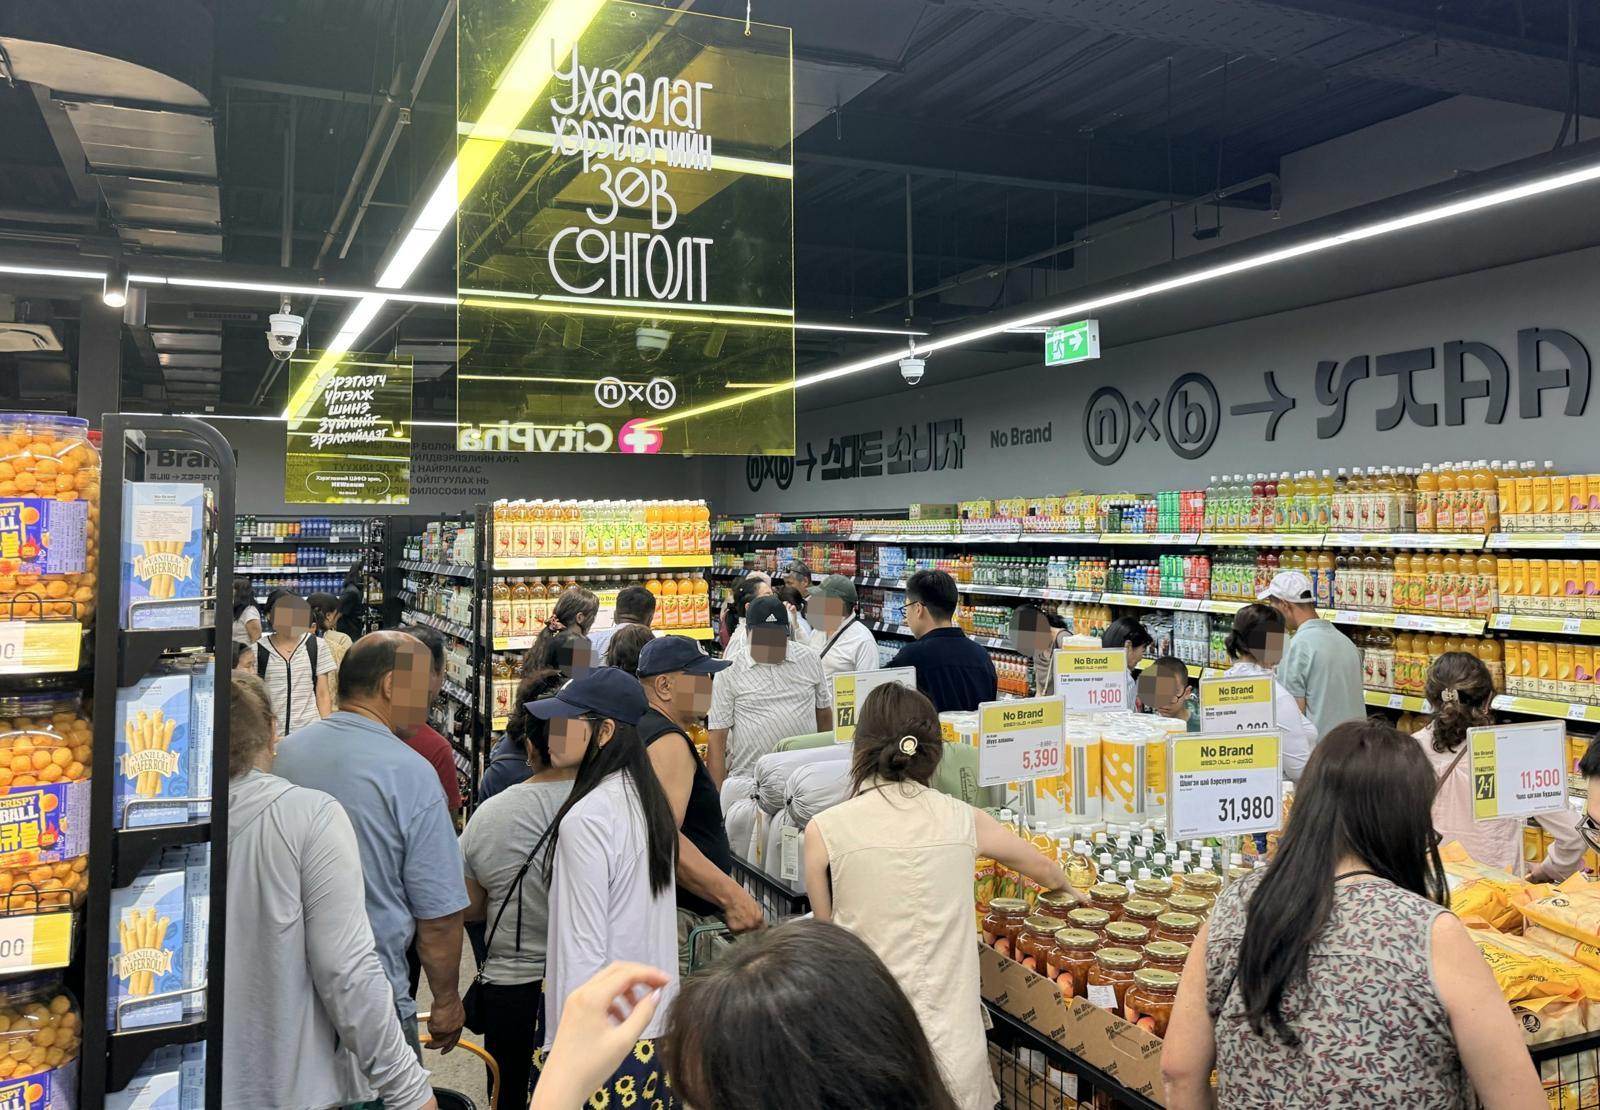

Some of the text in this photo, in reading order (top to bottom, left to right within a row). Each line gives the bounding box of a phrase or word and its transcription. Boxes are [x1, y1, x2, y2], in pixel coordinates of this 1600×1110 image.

[550, 38, 713, 130] Ухаалаг
[586, 163, 678, 231] ЗӨВ
[548, 226, 714, 303] СОНГОЛТ
[328, 402, 371, 416] ШИНЭ
[990, 421, 1053, 449] No Brand
[410, 487, 467, 496] ФИЛОСОФИ
[1073, 656, 1108, 665] No Brand
[1088, 689, 1121, 705] 11,900
[1218, 684, 1254, 696] No Brand
[1003, 707, 1044, 721] No Brand
[1023, 747, 1058, 770] 5,390
[1200, 744, 1254, 758] No Brand
[1476, 774, 1495, 799] 2+1
[1520, 768, 1560, 791] 11,500
[1218, 795, 1274, 823] 31,980
